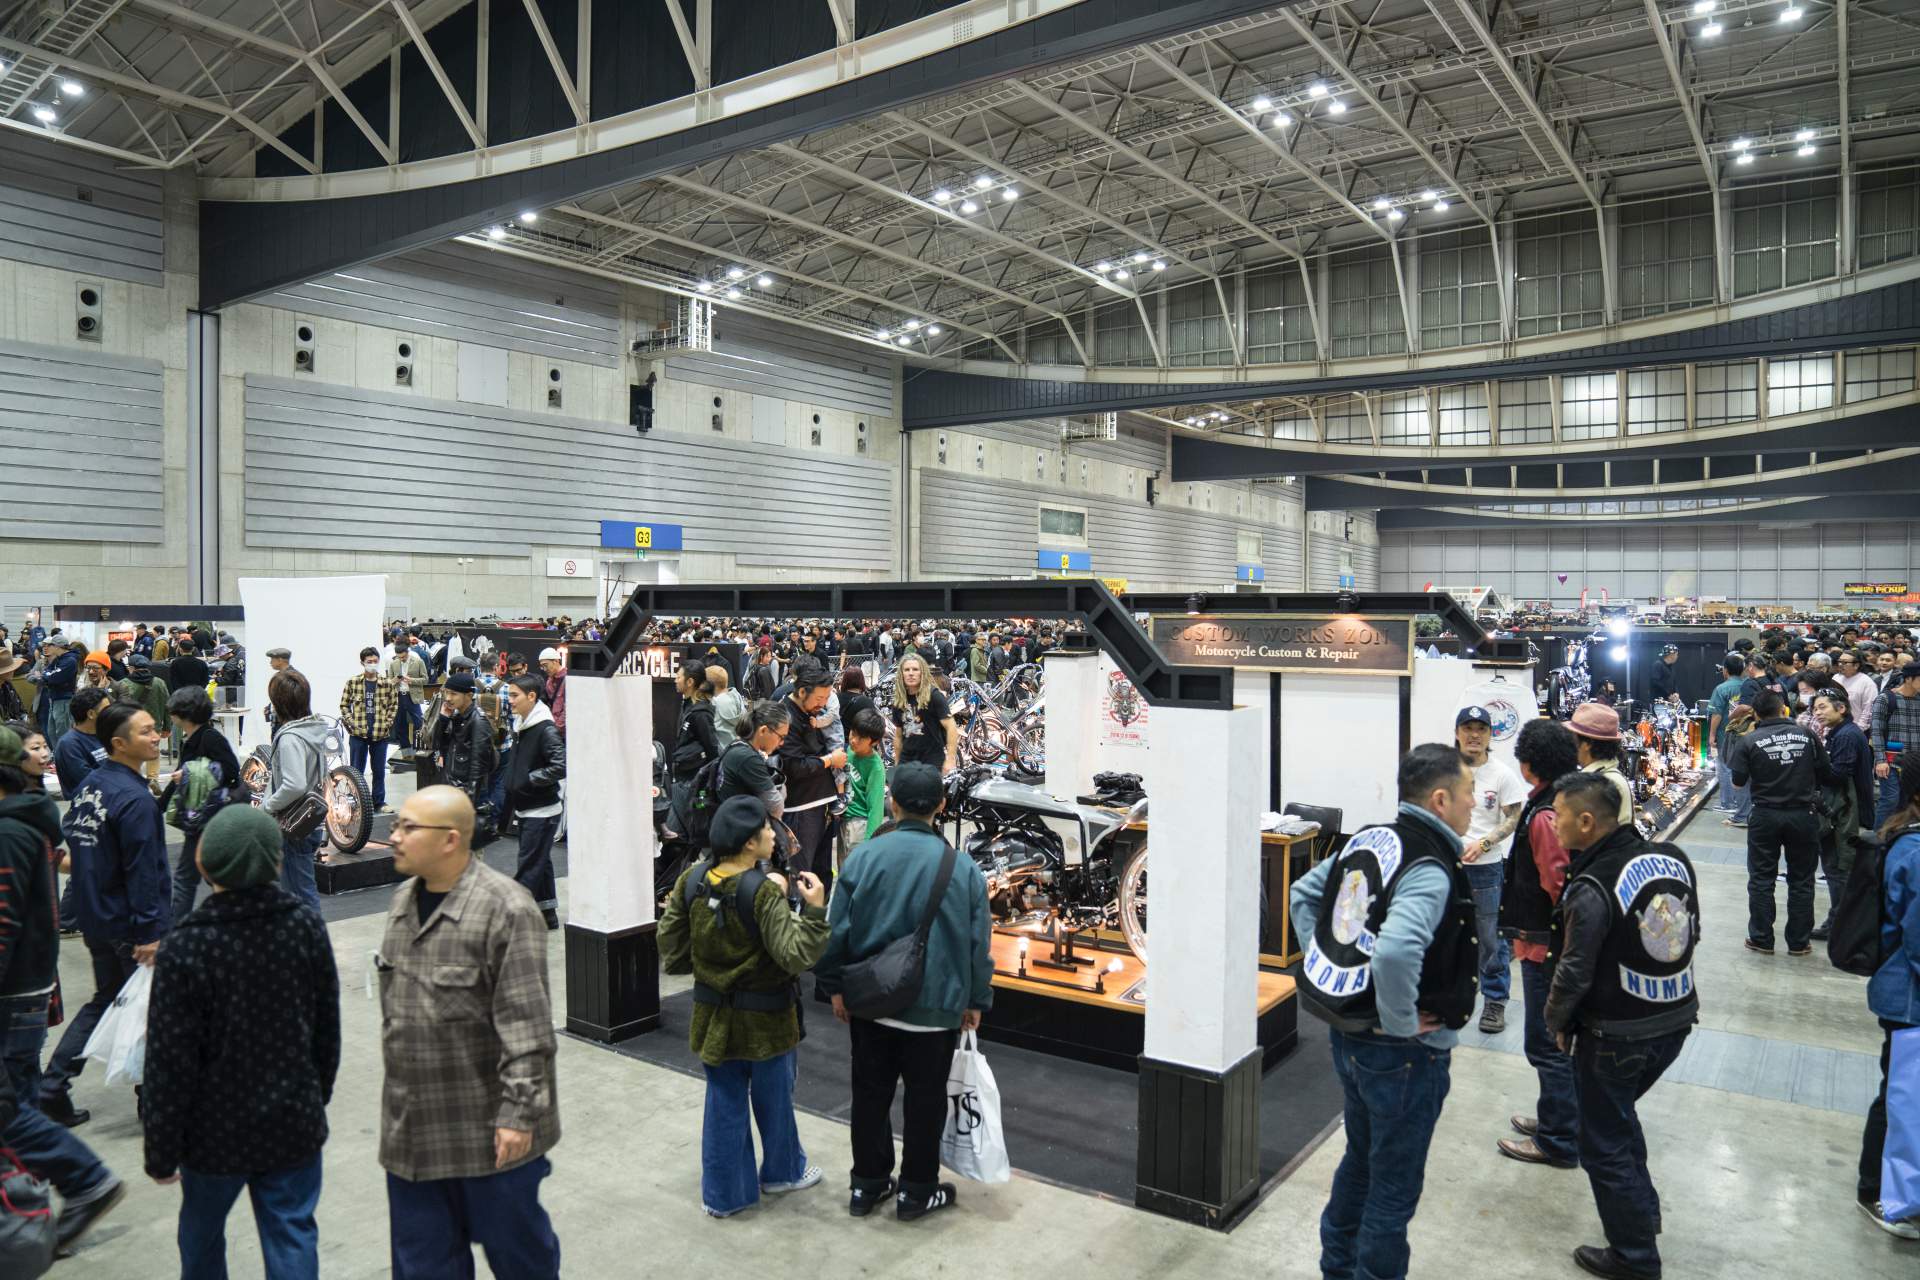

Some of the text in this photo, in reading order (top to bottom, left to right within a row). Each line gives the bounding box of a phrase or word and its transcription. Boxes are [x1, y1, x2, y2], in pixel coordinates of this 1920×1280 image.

[637, 531, 650, 544] G3
[1169, 624, 1390, 646] CUSTOM WORKS ZON
[1194, 645, 1359, 662] Motorcycle Custom & Repair
[1618, 857, 1690, 908] MOROCCO
